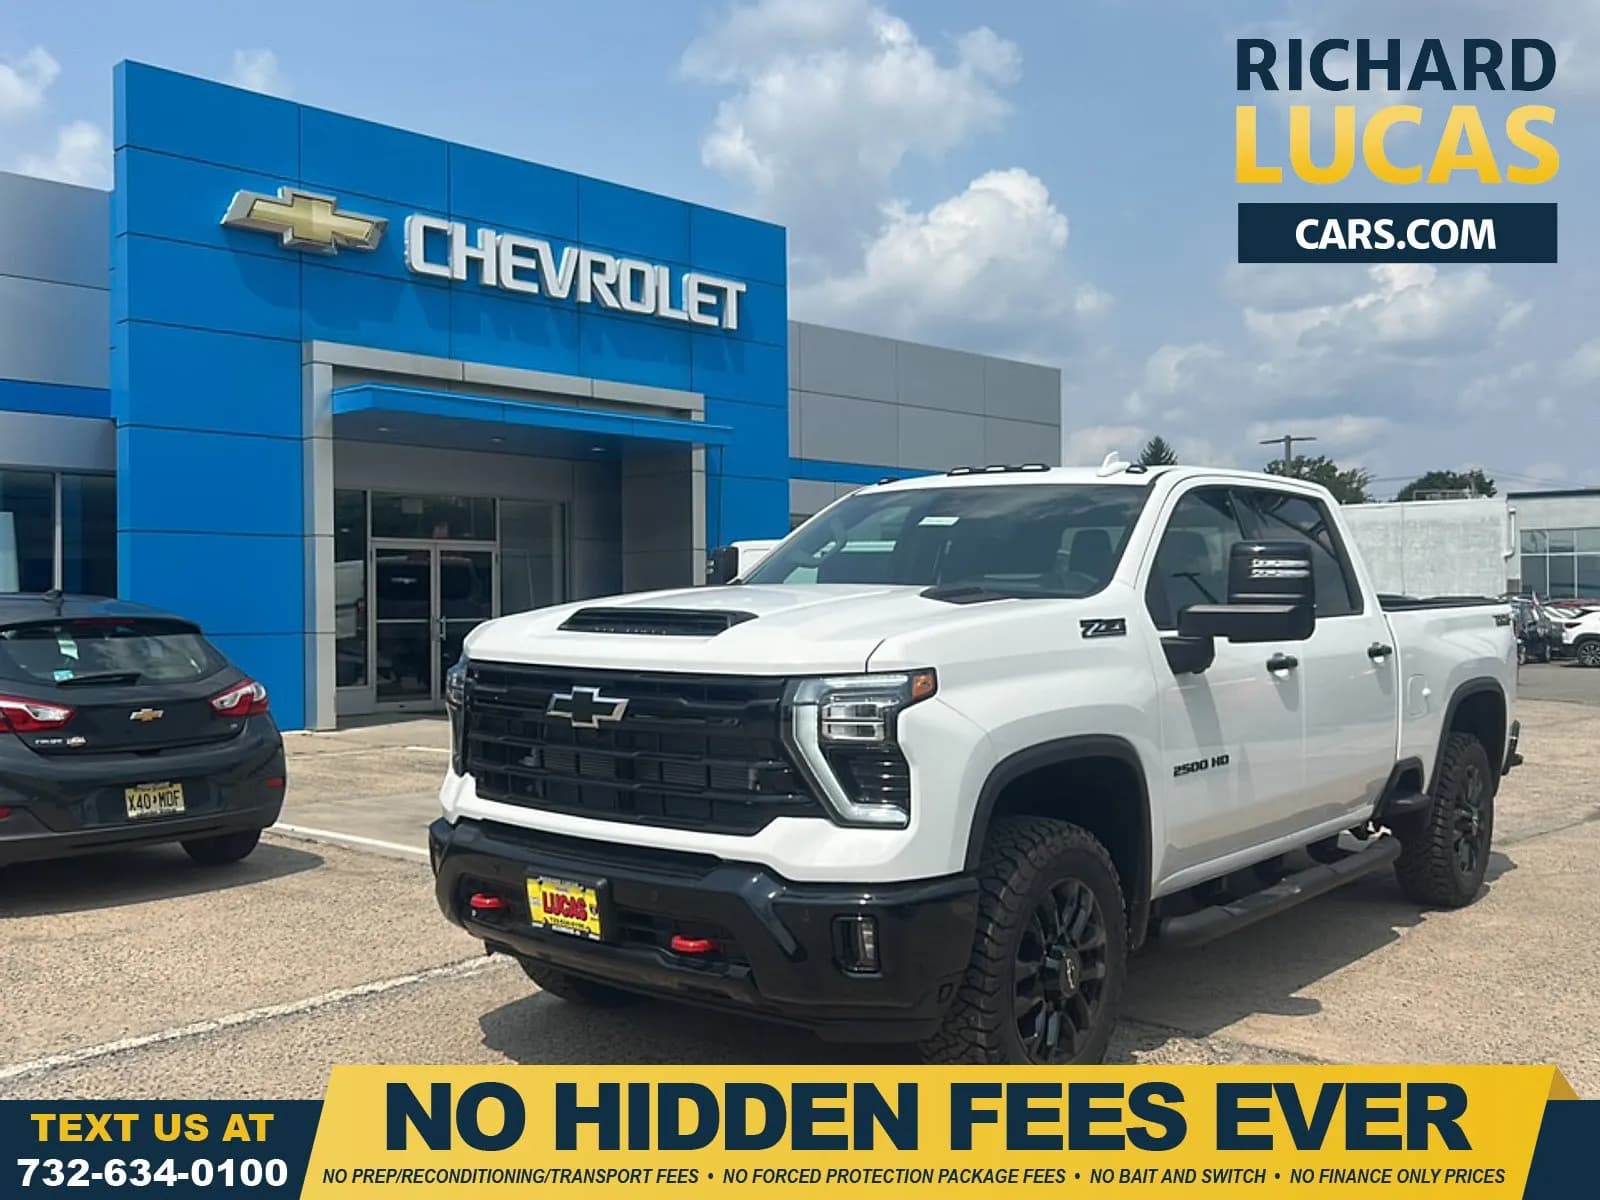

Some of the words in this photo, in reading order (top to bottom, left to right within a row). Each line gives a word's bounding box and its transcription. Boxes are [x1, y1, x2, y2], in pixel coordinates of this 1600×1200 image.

[404, 213, 746, 330] CHEVROLET
[1173, 759, 1208, 777] 2500
[1211, 754, 1230, 768] HD
[542, 891, 588, 921] LUCAS
